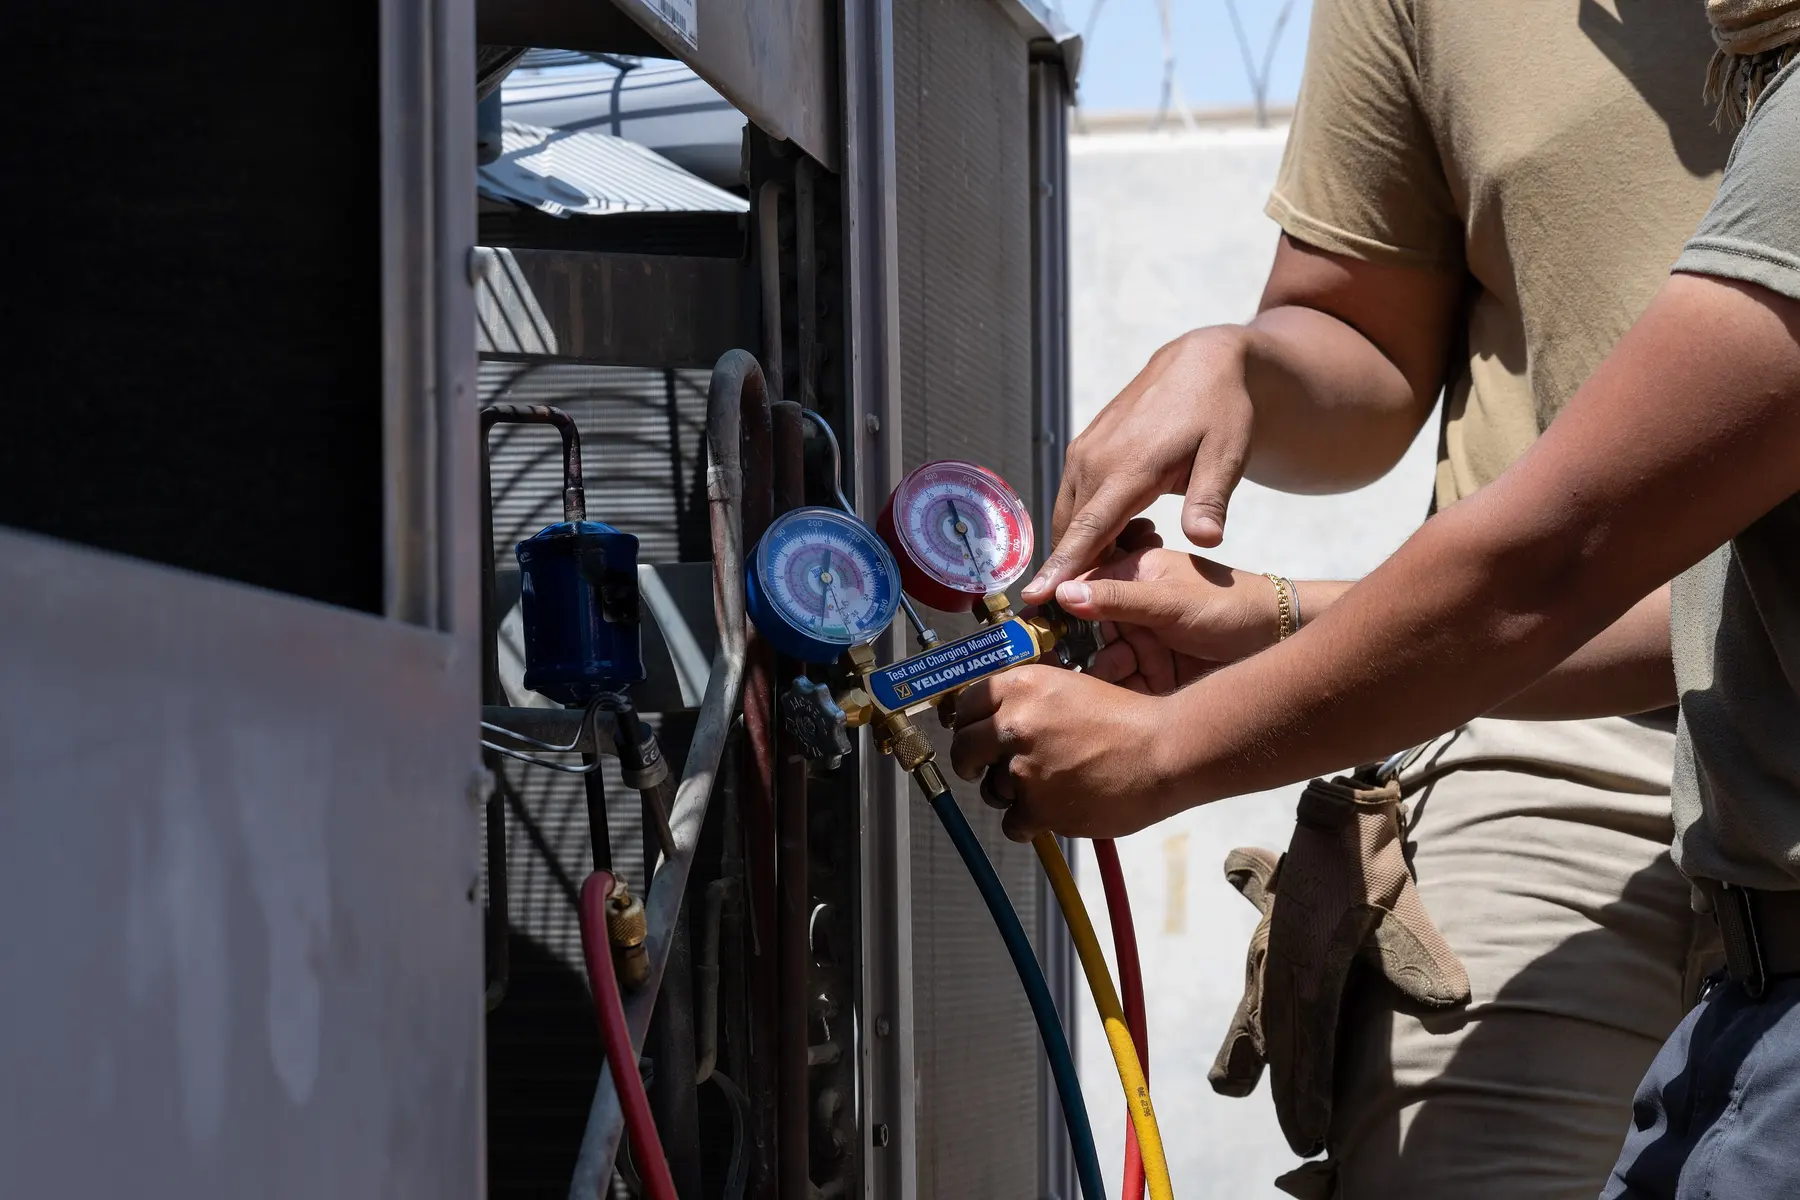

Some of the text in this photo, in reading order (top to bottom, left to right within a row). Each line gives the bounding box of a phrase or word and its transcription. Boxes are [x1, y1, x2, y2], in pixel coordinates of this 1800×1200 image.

[924, 472, 938, 480] 400
[962, 475, 978, 485] 500
[997, 499, 1009, 513] 600
[807, 519, 823, 527] 200
[846, 531, 862, 543] 250
[875, 561, 886, 576] 300
[878, 599, 889, 614] 350
[886, 628, 1008, 682] Test and Charging Manifold
[911, 664, 965, 692] YELLOW
[967, 645, 1013, 672] JACKET
